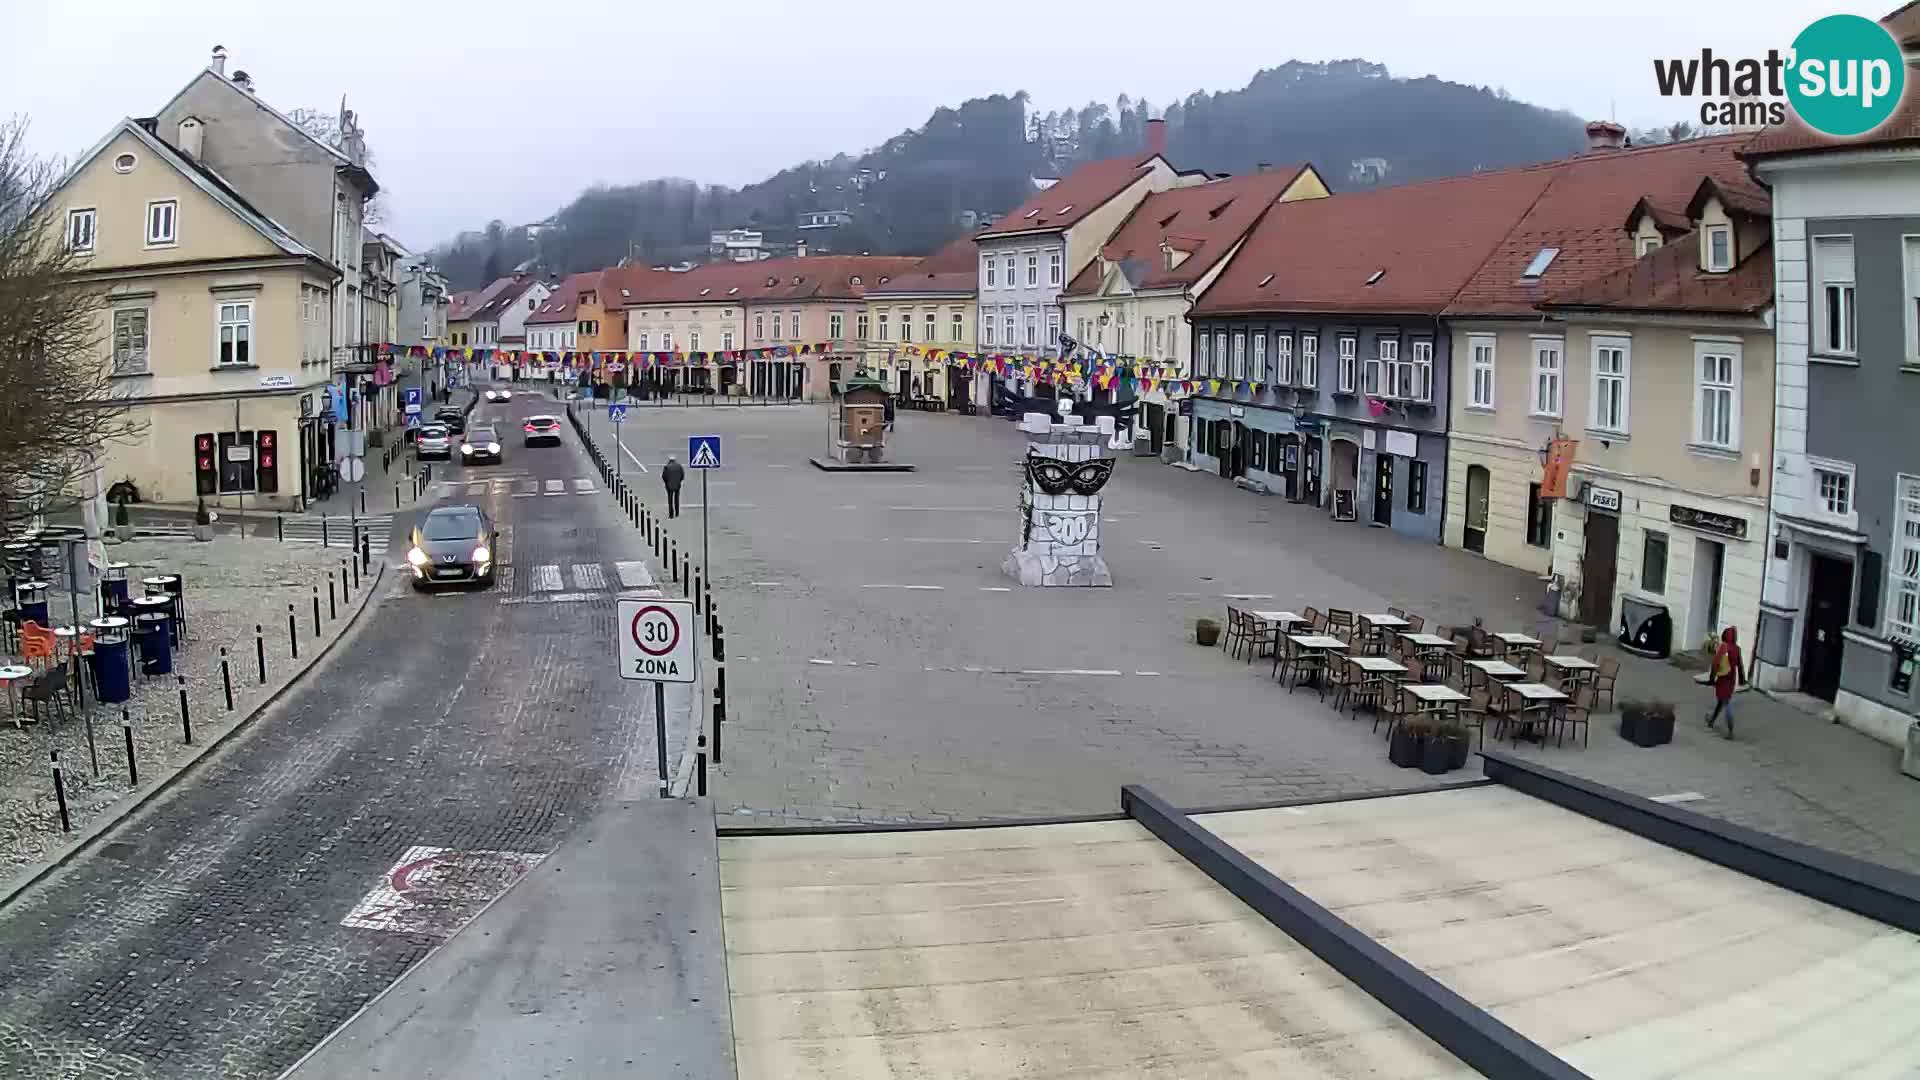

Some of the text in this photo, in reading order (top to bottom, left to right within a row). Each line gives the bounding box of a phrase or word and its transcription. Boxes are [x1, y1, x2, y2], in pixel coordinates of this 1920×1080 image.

[409, 391, 416, 401] P
[644, 621, 668, 643] 30
[635, 658, 679, 675] ZONA
